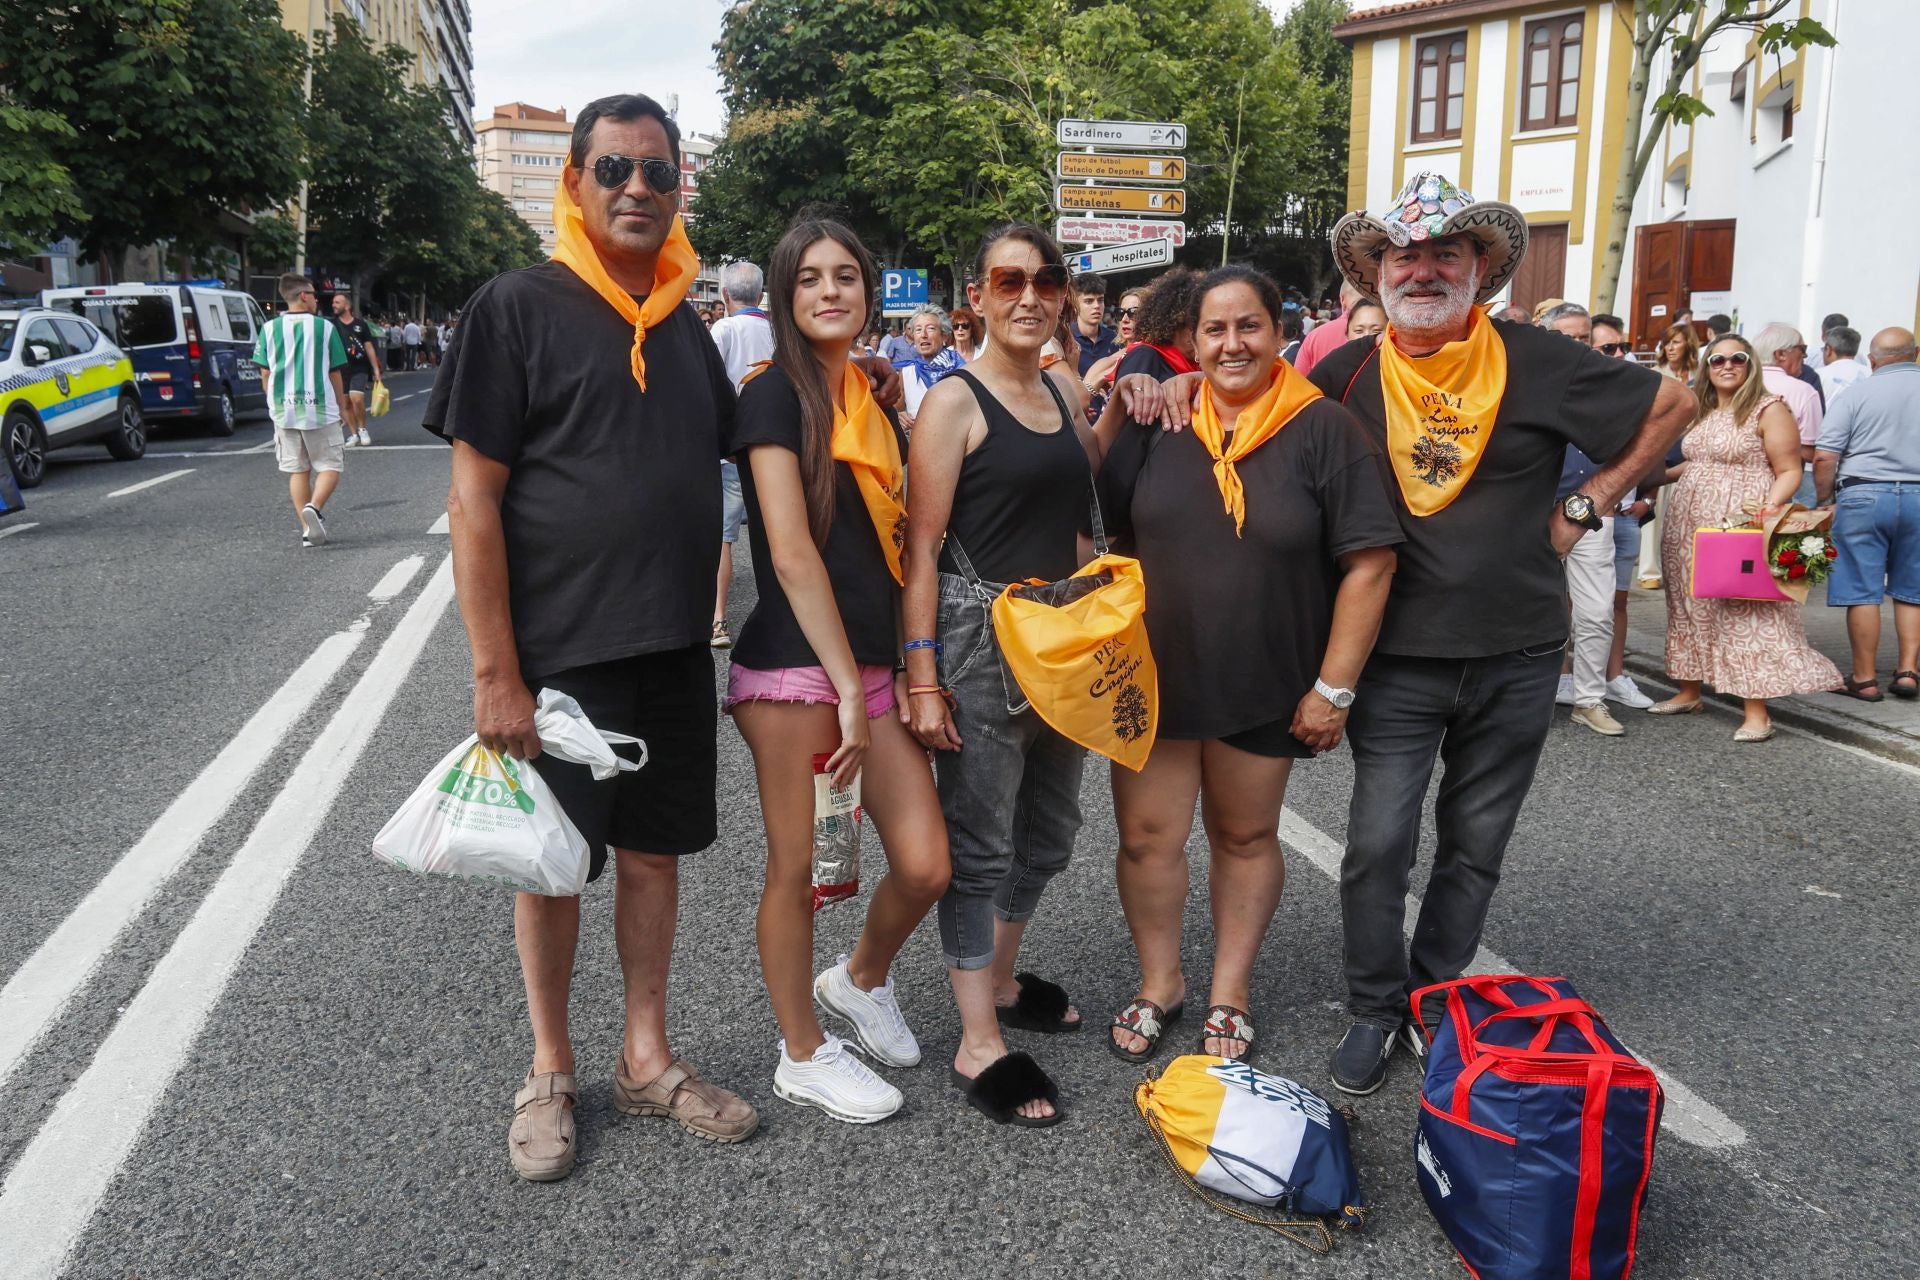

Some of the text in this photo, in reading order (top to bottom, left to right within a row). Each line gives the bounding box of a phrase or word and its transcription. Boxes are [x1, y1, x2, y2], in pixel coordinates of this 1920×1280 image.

[1065, 127, 1122, 139] Sardinero
[1064, 157, 1086, 165] campo
[1064, 165, 1093, 174] Palacio
[1108, 167, 1144, 176] Deportes
[1064, 188, 1086, 196] campo
[1100, 189, 1113, 197] golf
[1112, 248, 1164, 264] Hospitales
[885, 273, 902, 298] P
[1429, 407, 1458, 423] Las
[1104, 653, 1130, 678] Las
